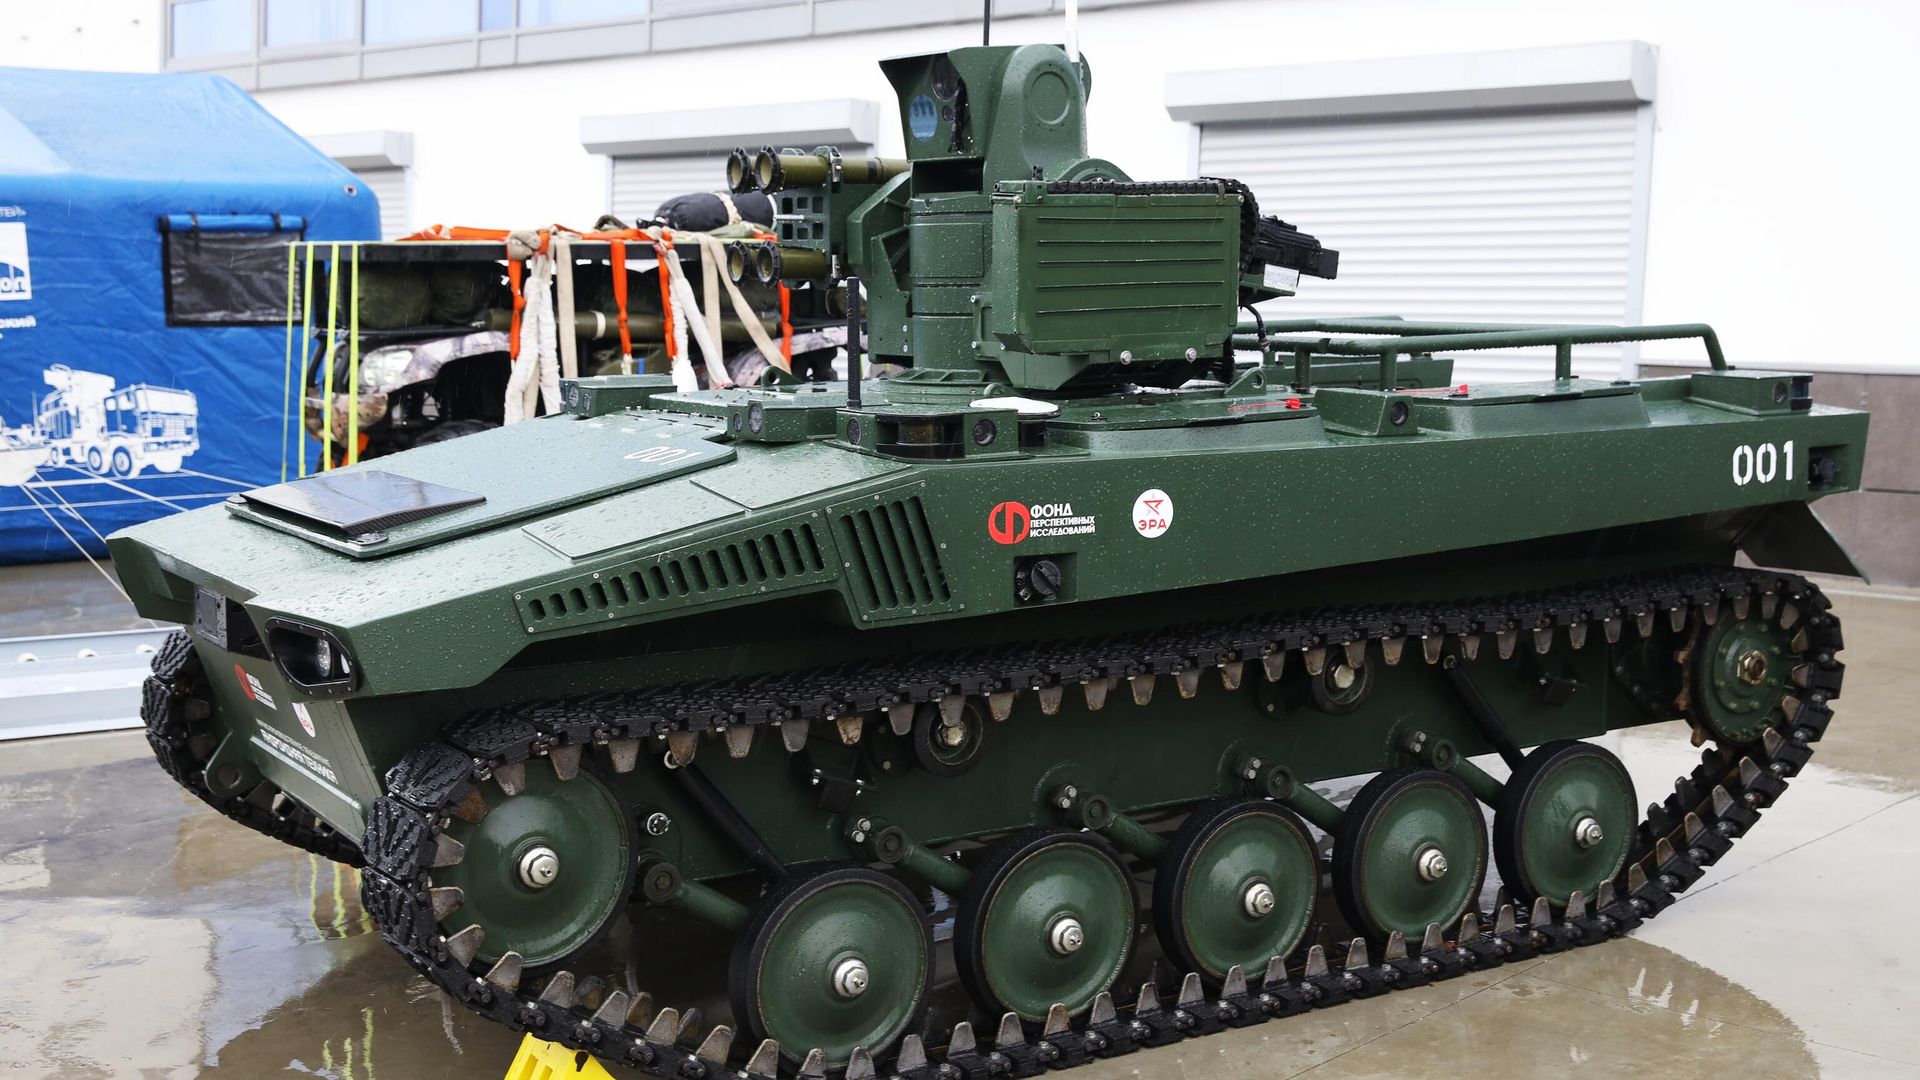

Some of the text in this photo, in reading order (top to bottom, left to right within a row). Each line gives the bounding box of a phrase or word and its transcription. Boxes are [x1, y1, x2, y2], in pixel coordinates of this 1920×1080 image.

[623, 446, 704, 466] 001
[1732, 440, 1793, 486] 001
[1030, 503, 1073, 518] ФОНД
[1030, 515, 1095, 528] ПЕРСПЕКТИВНЫХ
[1138, 518, 1167, 531] ЭРА
[1029, 523, 1096, 538] ИССЛЕДОВАНИЙ
